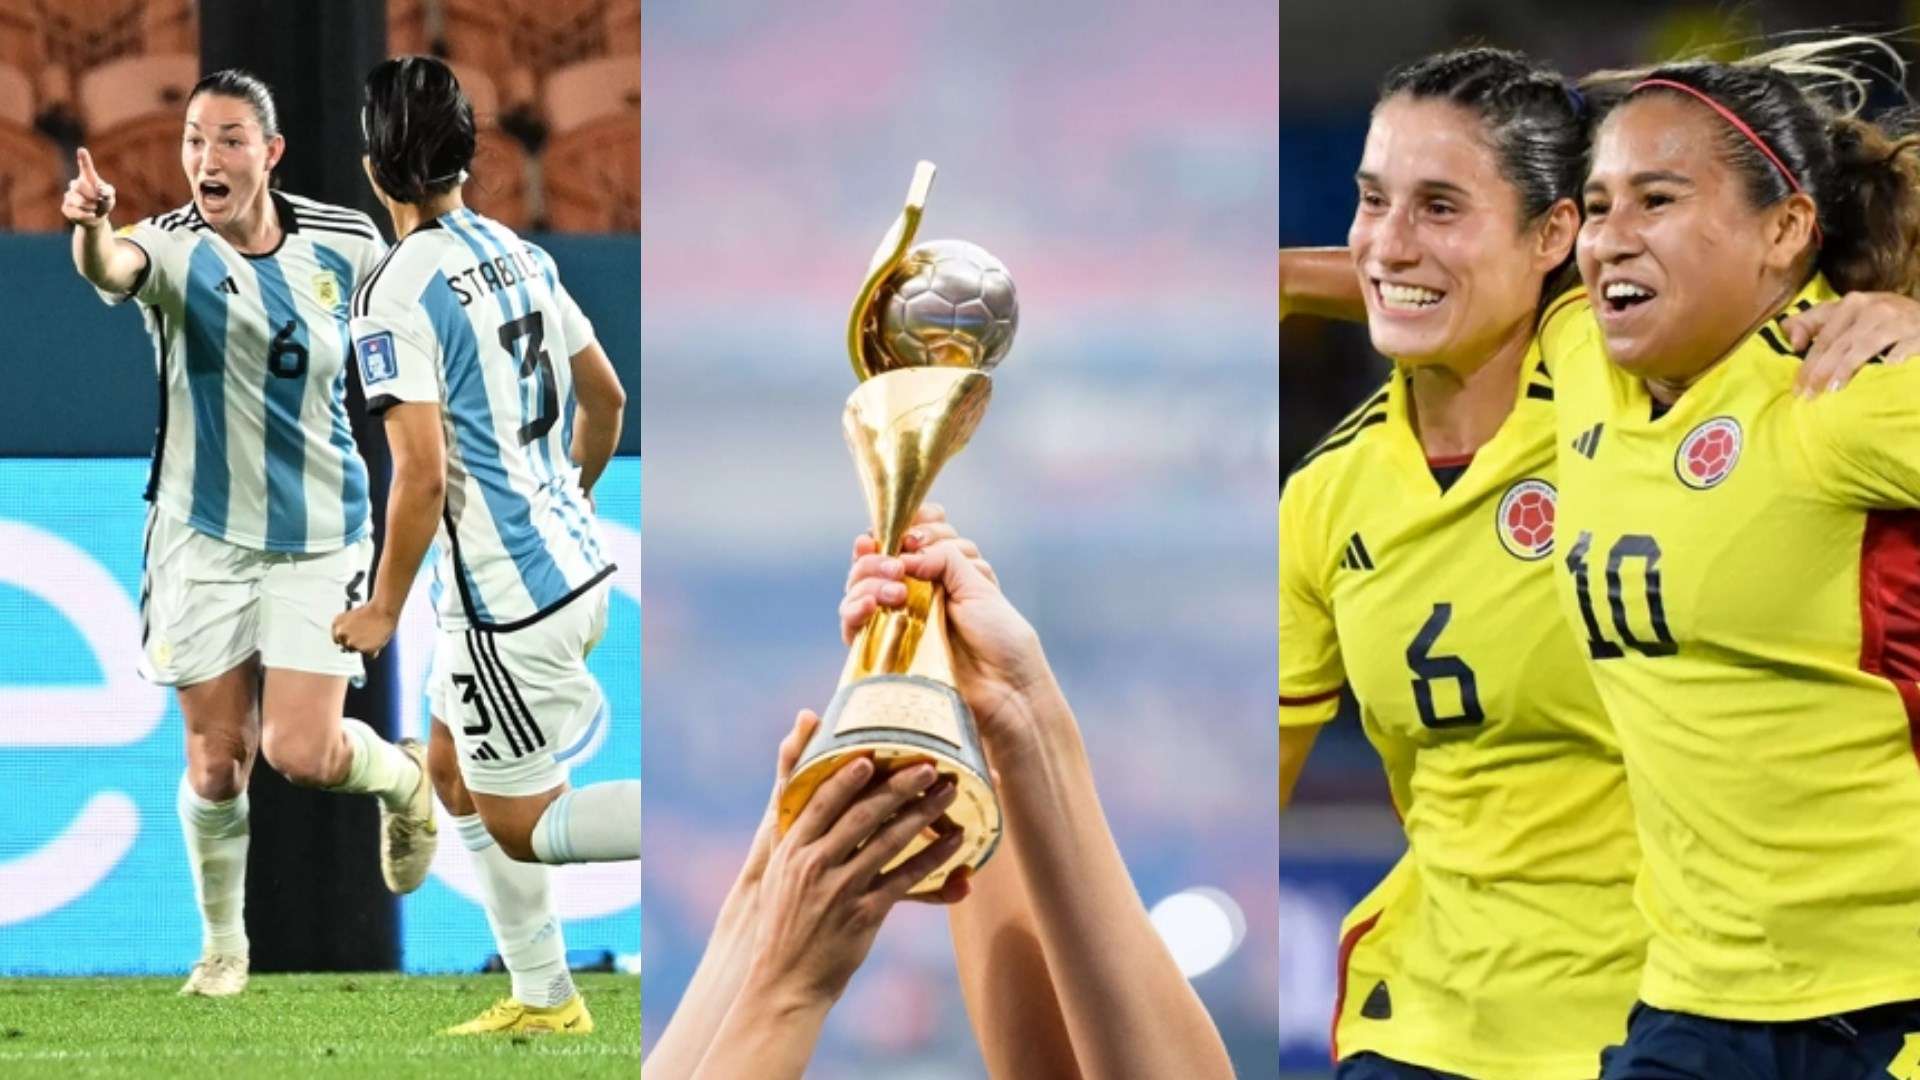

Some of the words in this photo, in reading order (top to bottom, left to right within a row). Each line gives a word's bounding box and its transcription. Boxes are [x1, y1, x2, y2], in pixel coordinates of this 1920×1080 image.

[268, 320, 309, 379] 6
[498, 311, 559, 447] 3
[1565, 531, 1678, 660] 10
[452, 673, 492, 736] 3
[1406, 603, 1484, 728] 6
